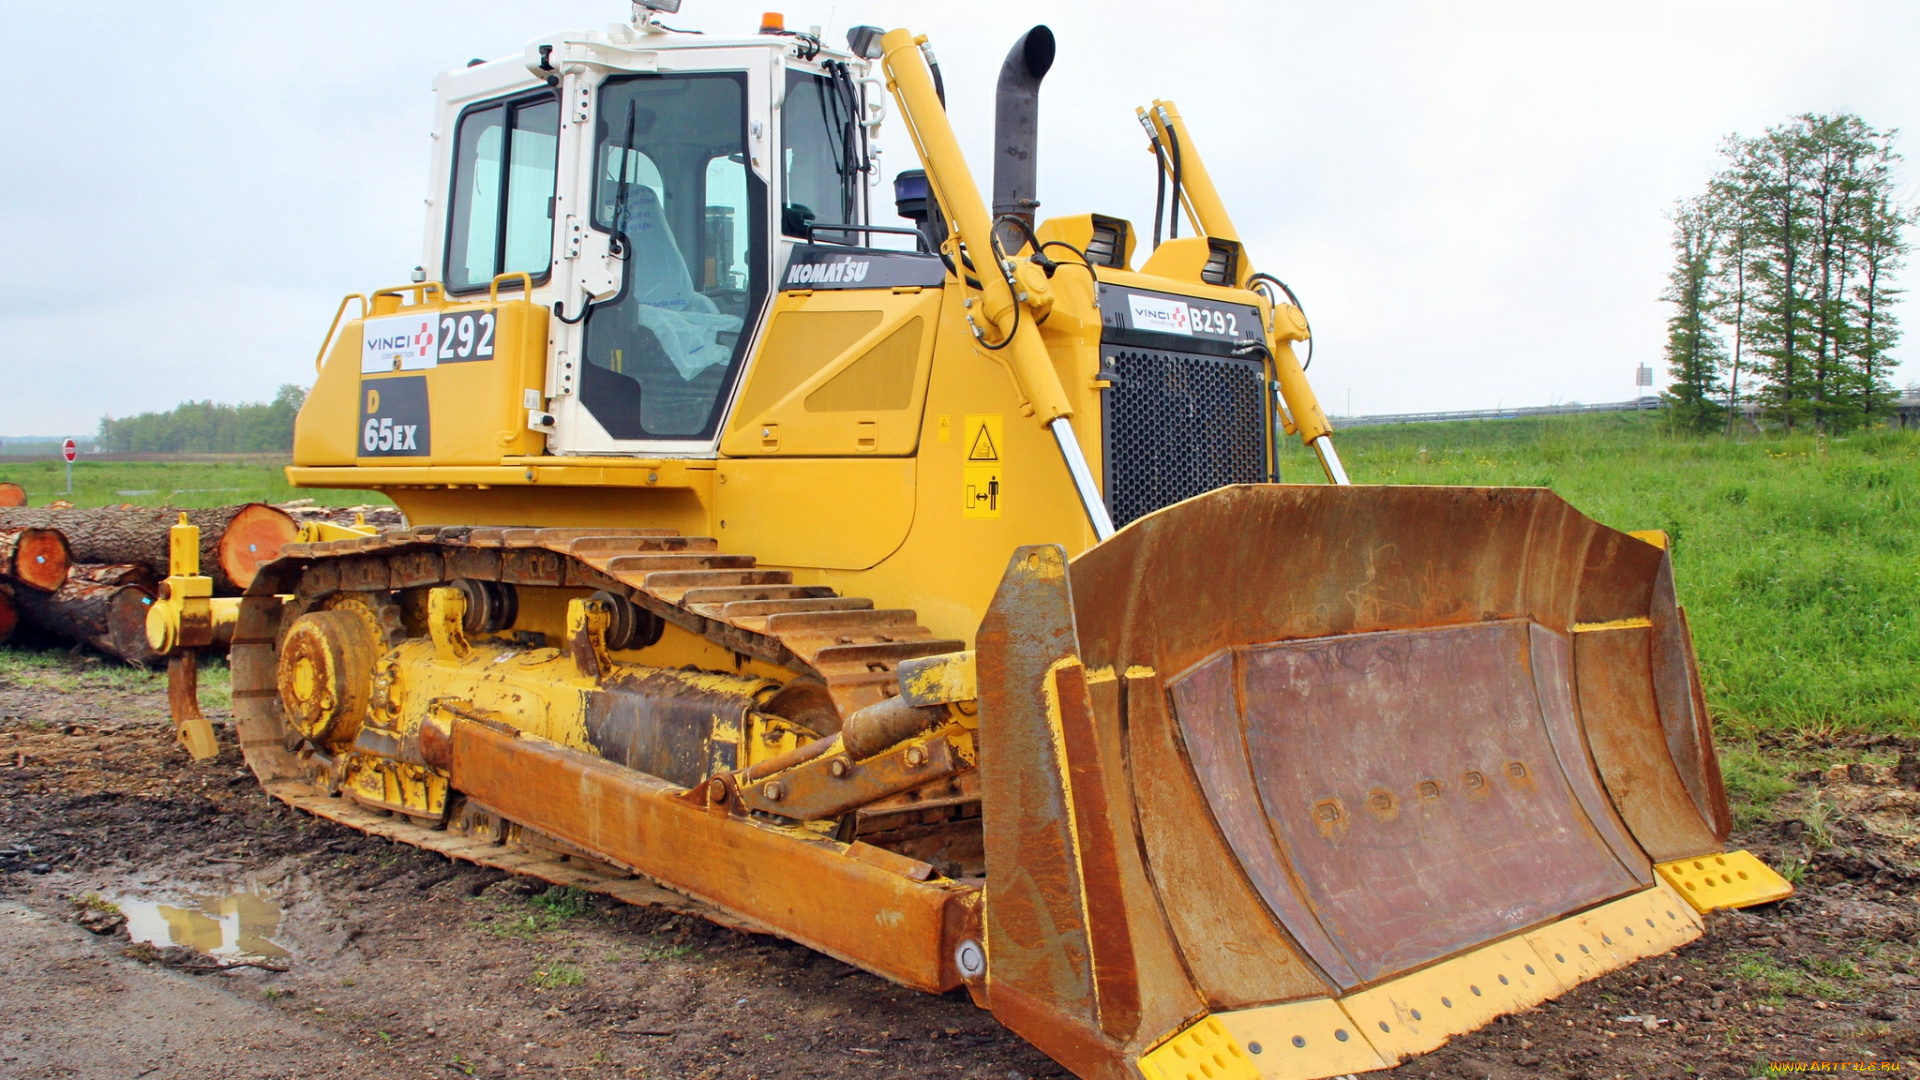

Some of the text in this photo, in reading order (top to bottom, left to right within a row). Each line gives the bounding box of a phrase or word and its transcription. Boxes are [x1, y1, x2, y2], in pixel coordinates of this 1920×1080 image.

[787, 257, 869, 283] KOMATSU
[1135, 308, 1170, 320] VINCI
[1189, 307, 1238, 336] B292
[367, 335, 411, 350] VINCI
[439, 314, 495, 358] 292
[367, 389, 380, 414] D
[364, 418, 417, 451] 65EX
